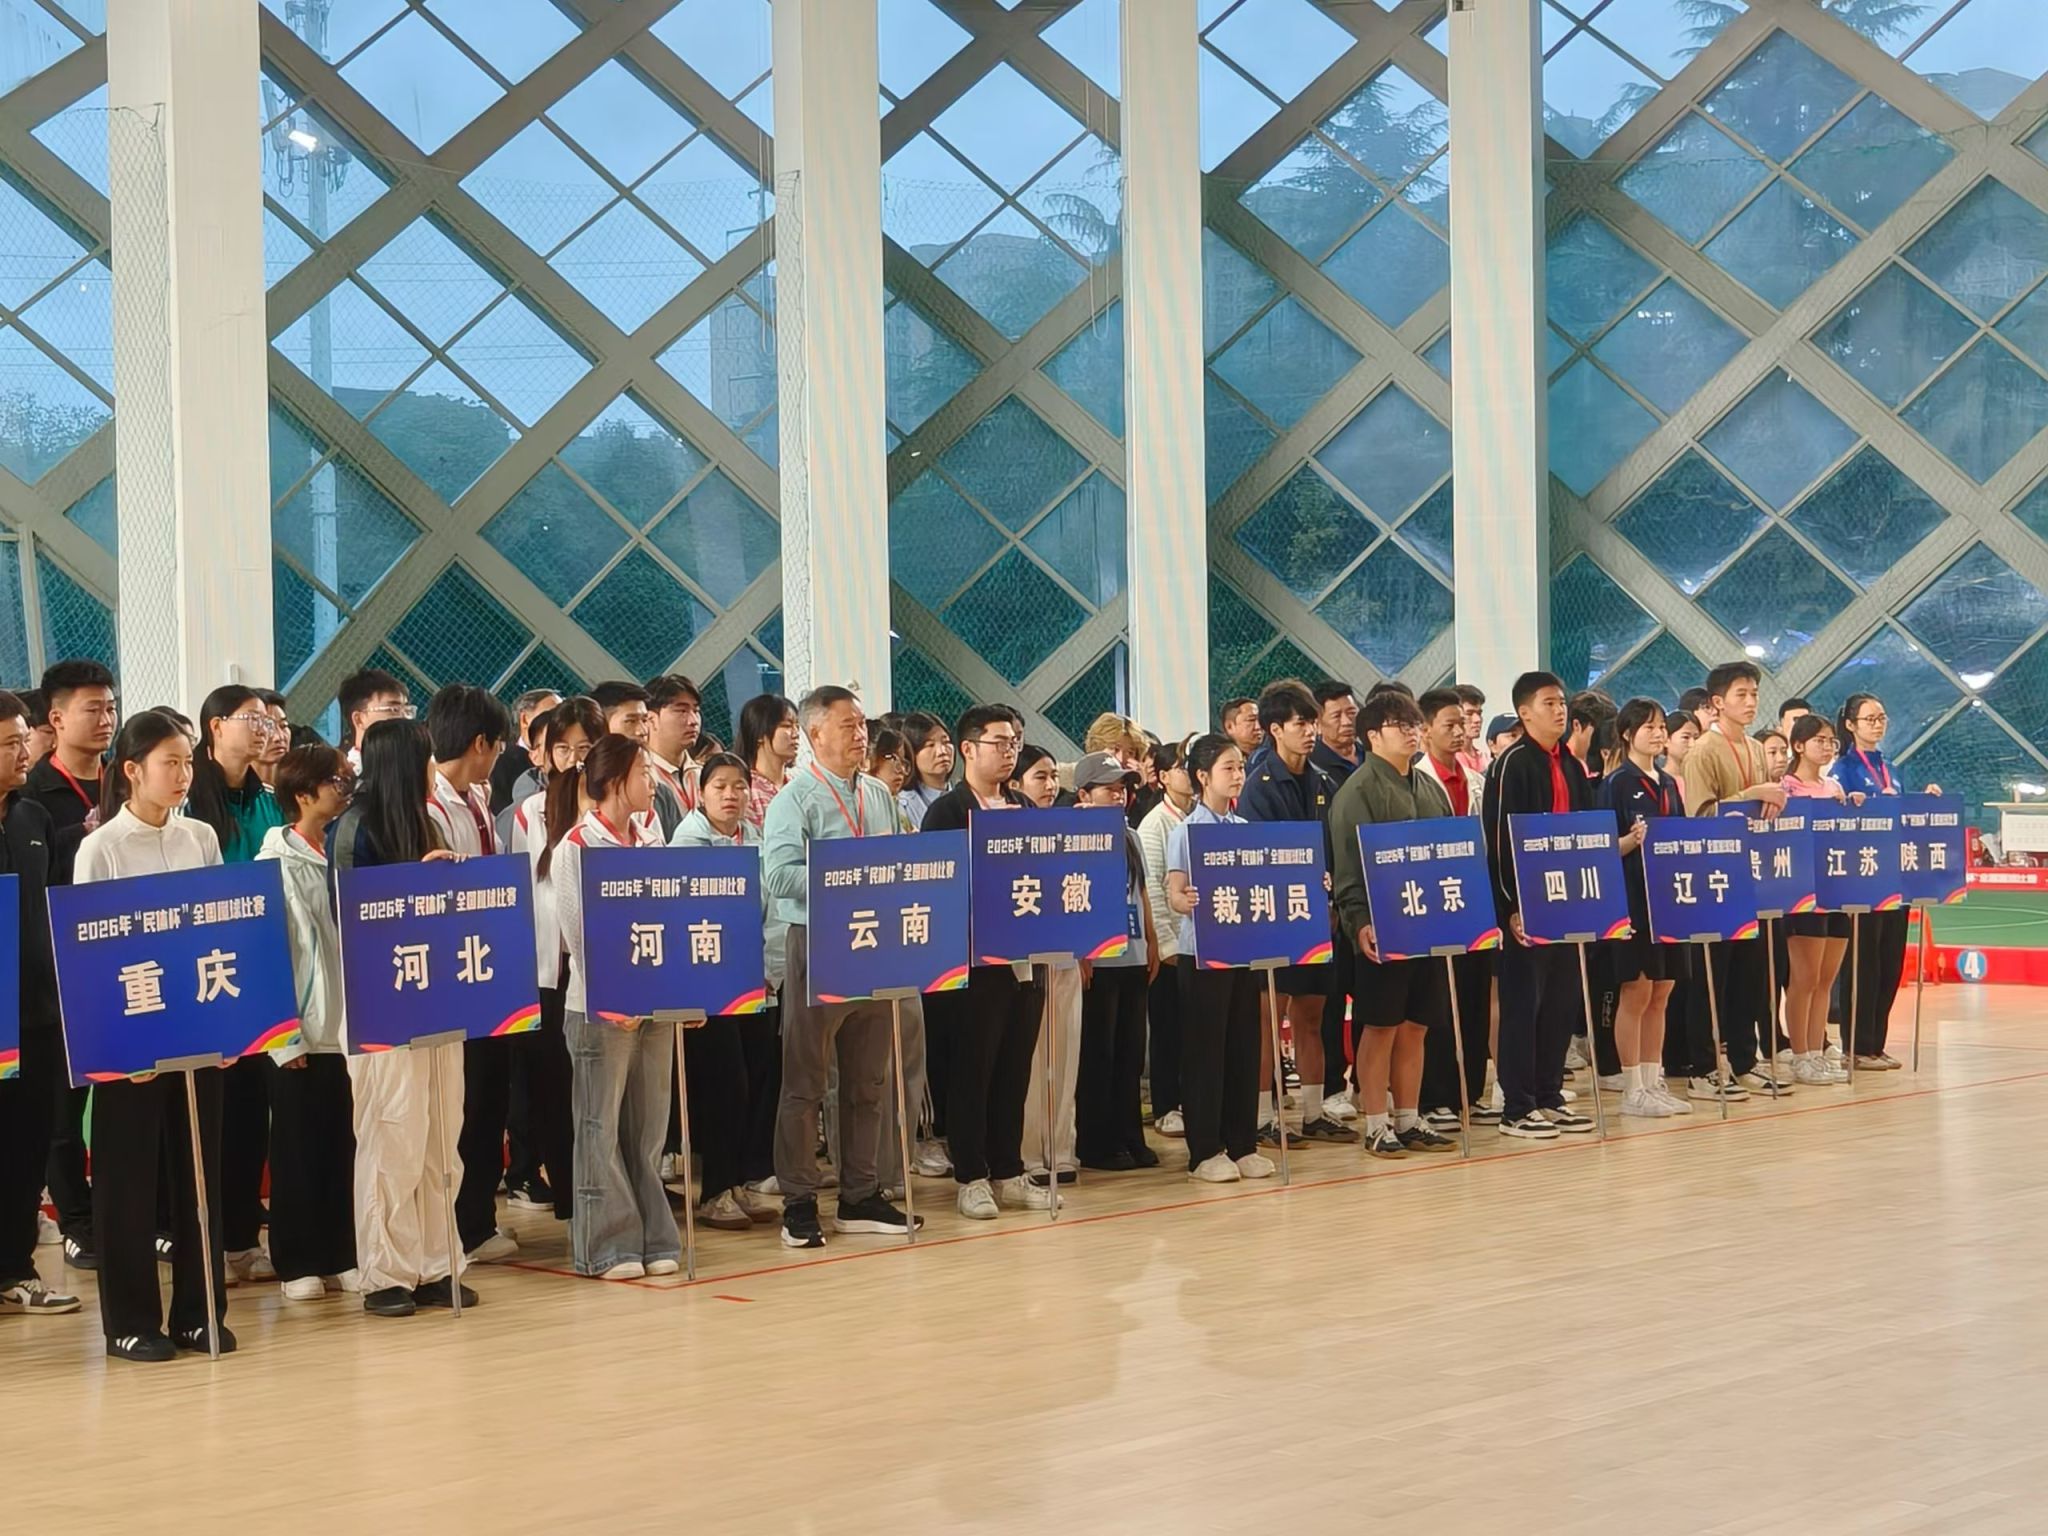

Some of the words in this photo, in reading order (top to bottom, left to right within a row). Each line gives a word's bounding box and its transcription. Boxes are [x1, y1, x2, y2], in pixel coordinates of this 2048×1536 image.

[1827, 846, 1878, 876] 江苏
[1901, 842, 1947, 871] 陕西
[1012, 873, 1091, 916] 安徽
[1213, 884, 1311, 923] 裁判员
[1402, 877, 1464, 916] 北京
[1545, 866, 1600, 902] 四川
[1674, 870, 1729, 903] 辽宁
[631, 919, 722, 966] 河南
[849, 903, 931, 950] 云南
[118, 949, 240, 1015] 重庆
[393, 935, 493, 990] 河北
[1964, 951, 1980, 979] 4
